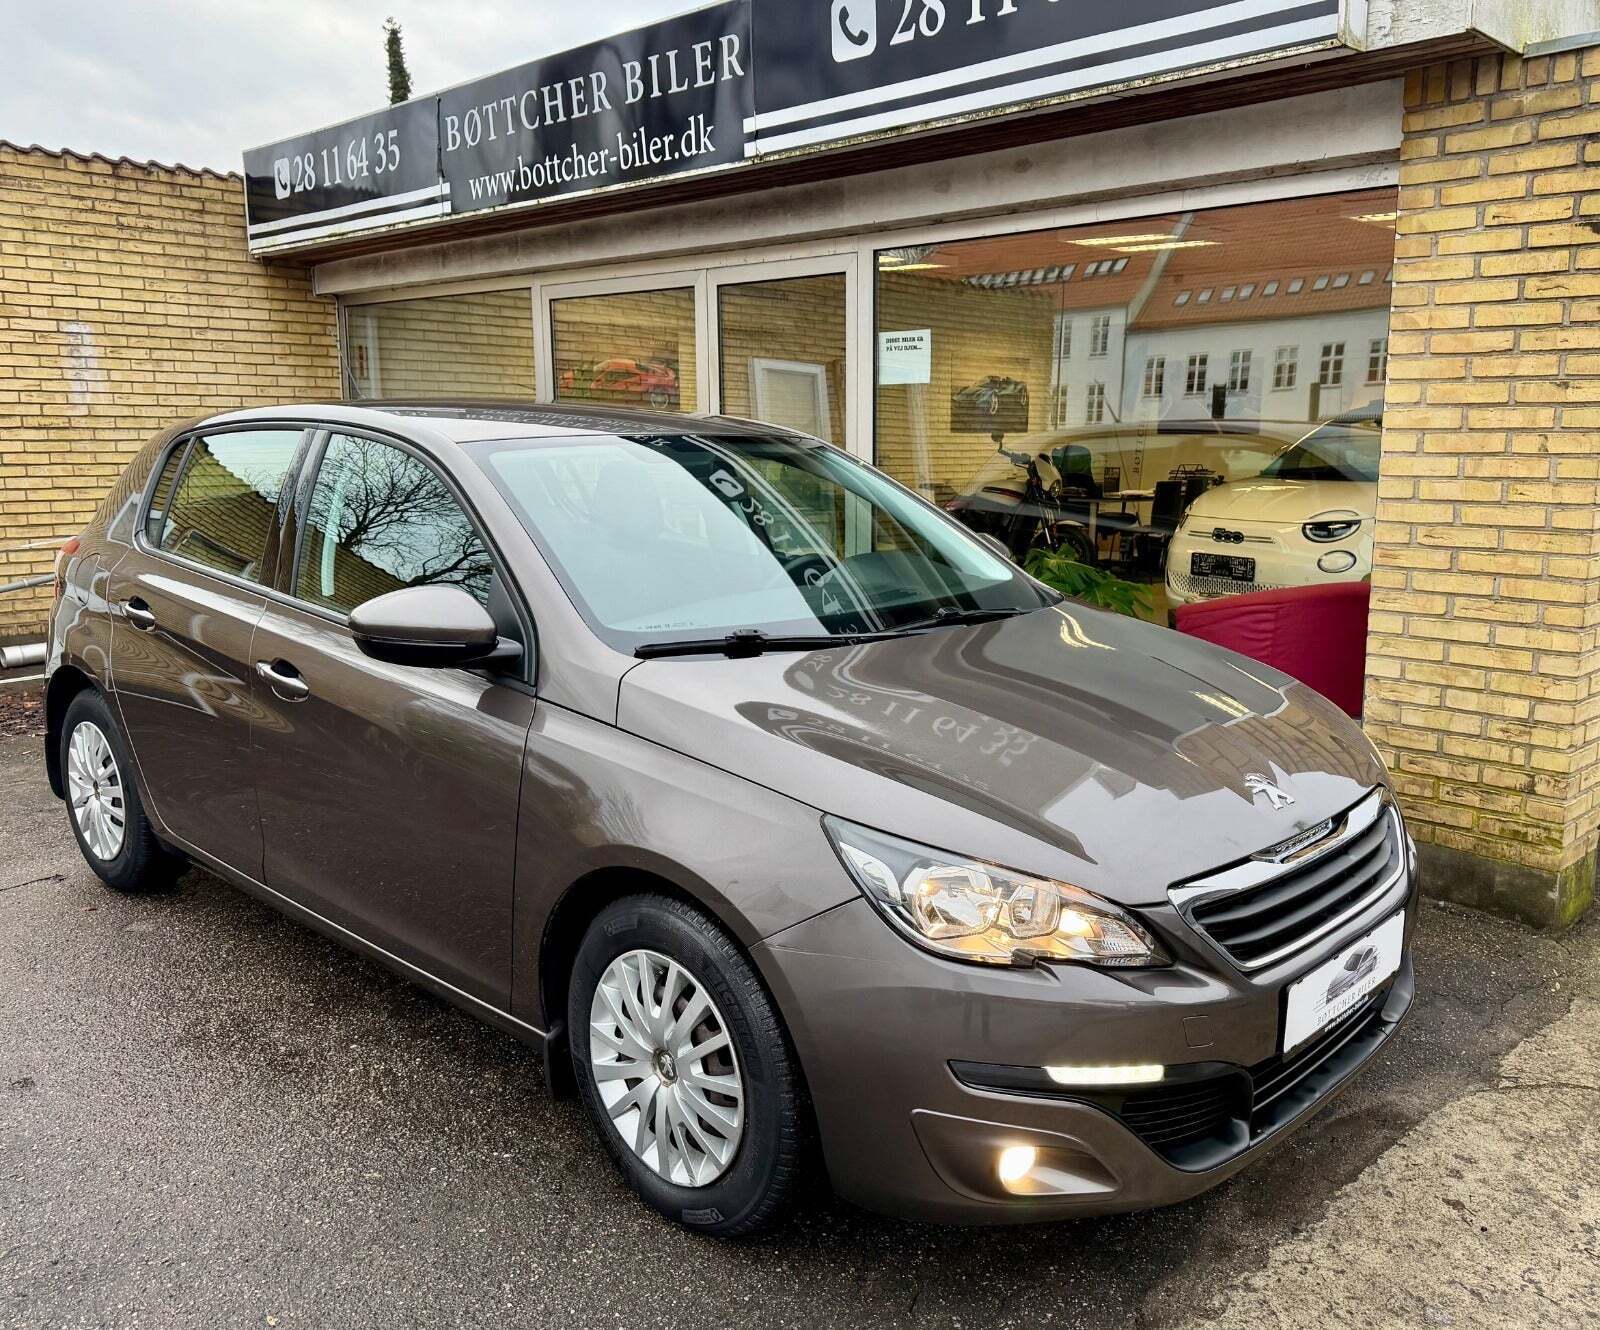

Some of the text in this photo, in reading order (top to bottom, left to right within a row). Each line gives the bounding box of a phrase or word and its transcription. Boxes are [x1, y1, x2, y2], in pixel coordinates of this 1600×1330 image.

[445, 33, 745, 151] BØTTCHER BILER
[293, 129, 400, 193] 28 11 64 35
[469, 114, 716, 200] www.bottcher-biler.dk
